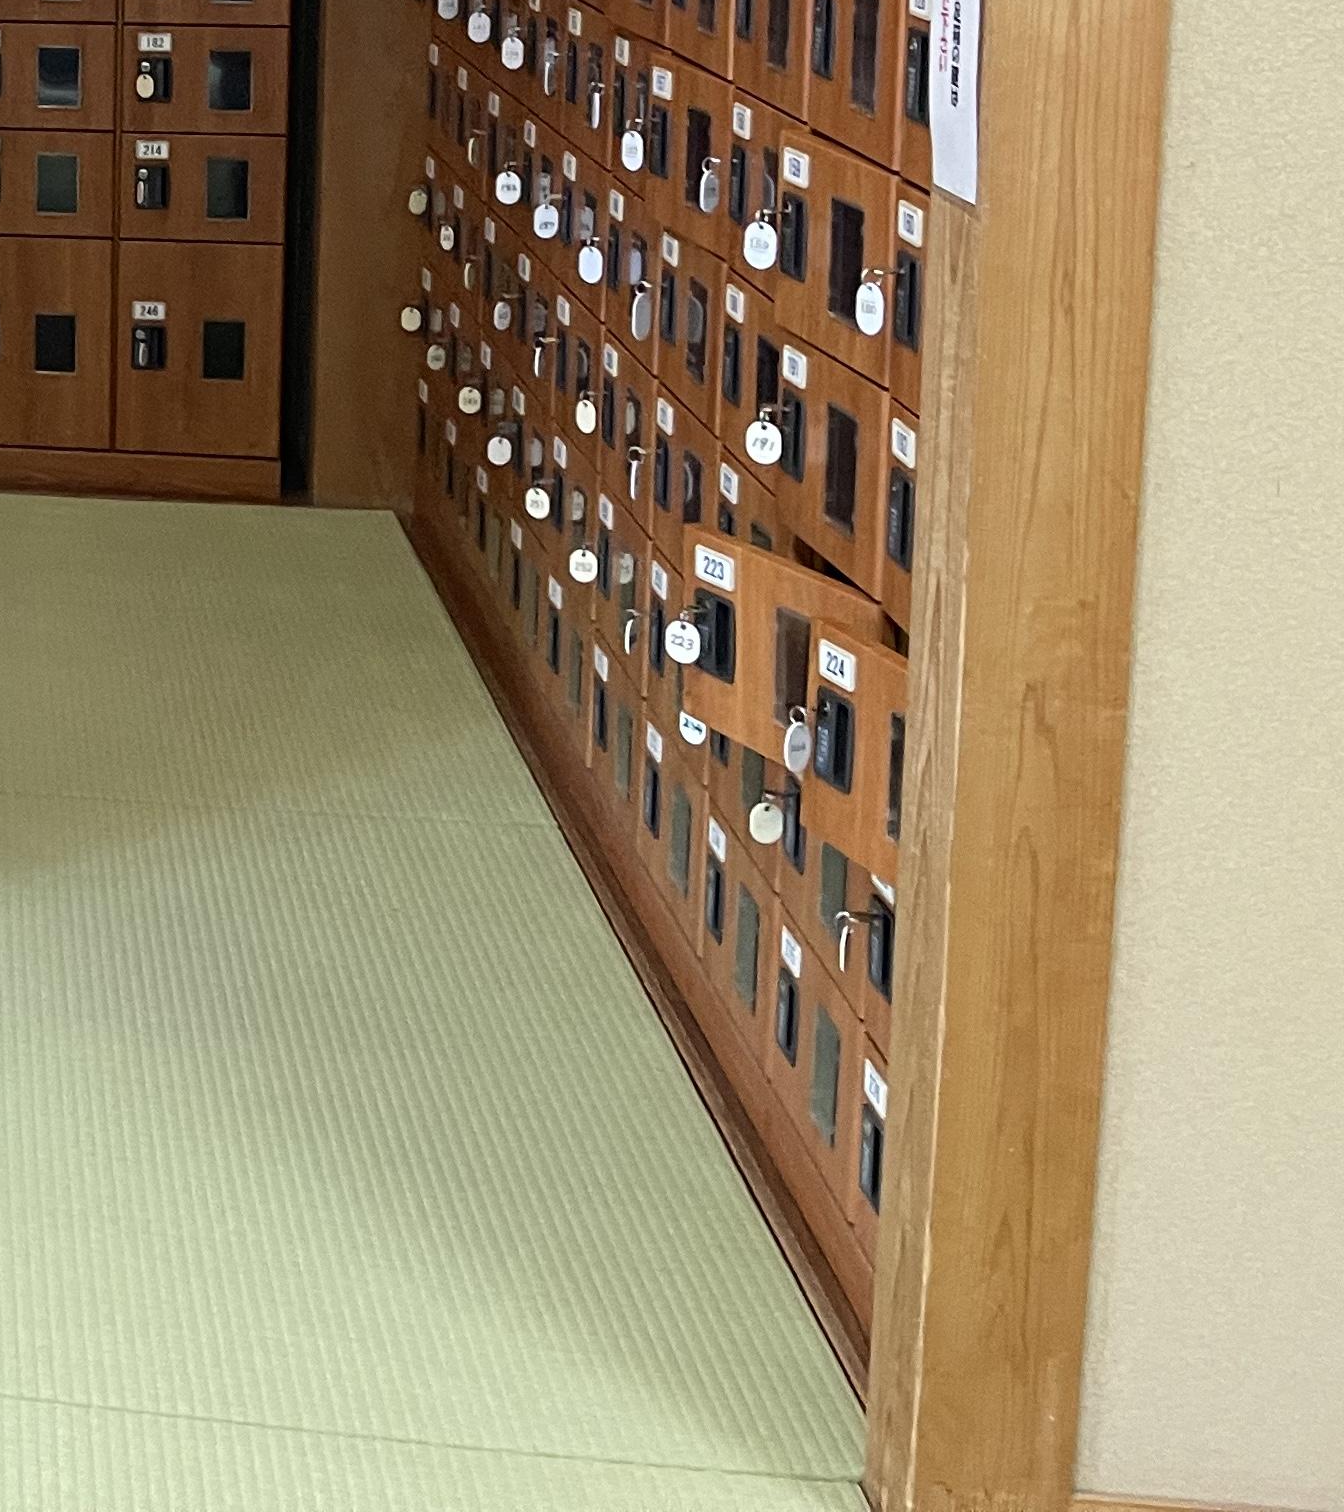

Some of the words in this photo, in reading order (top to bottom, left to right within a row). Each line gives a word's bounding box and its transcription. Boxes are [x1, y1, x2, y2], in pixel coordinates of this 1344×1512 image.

[752, 436, 775, 452] 191
[702, 555, 726, 581] 223
[670, 634, 695, 653] 223
[824, 651, 846, 678] 224
